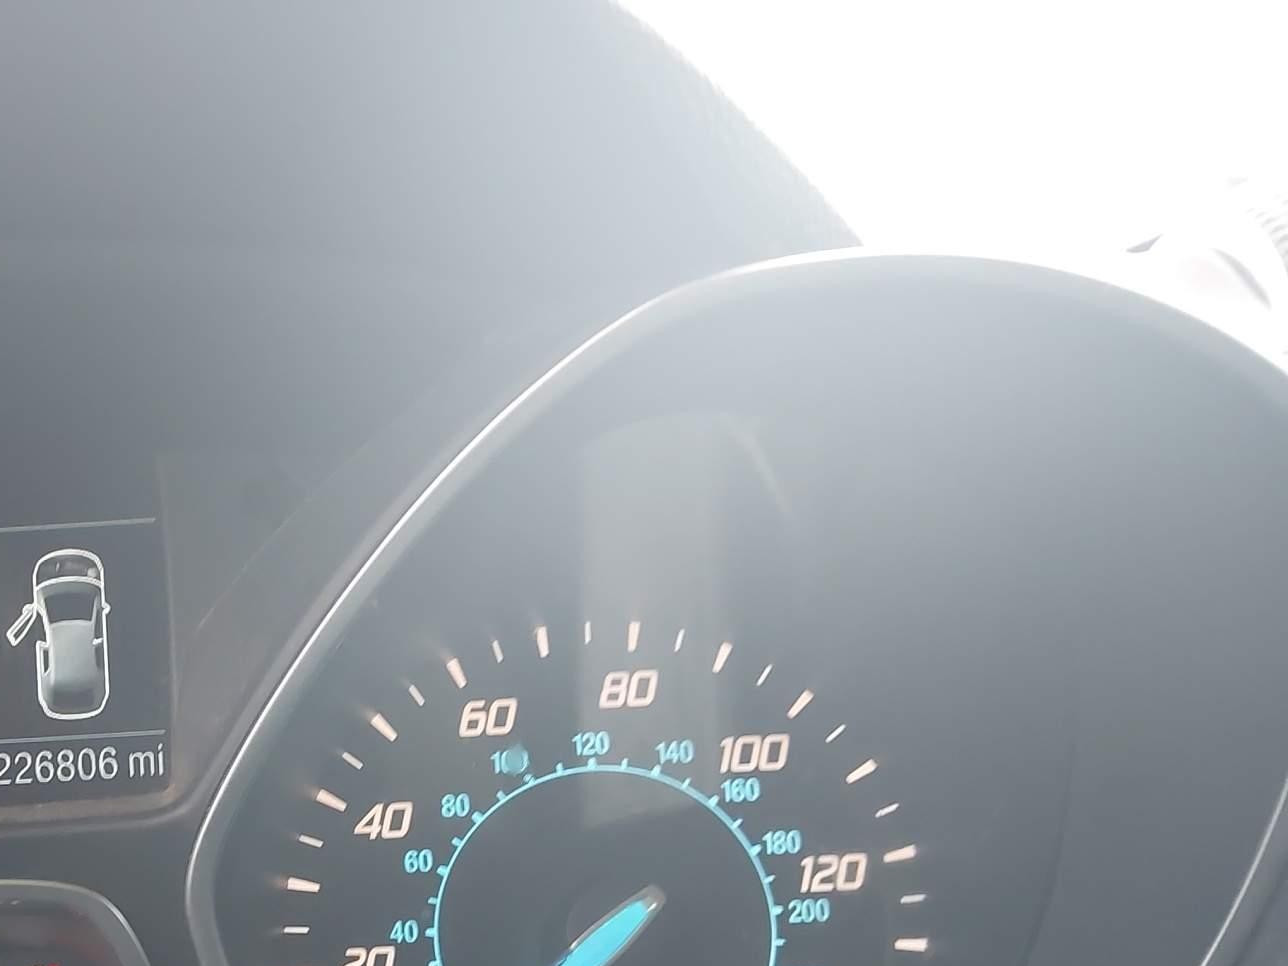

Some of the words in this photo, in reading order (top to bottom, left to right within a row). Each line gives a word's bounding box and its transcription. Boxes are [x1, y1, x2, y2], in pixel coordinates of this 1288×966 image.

[599, 669, 659, 710] 80
[458, 697, 518, 738] 60
[572, 731, 610, 756] 120
[655, 739, 696, 766] 140
[718, 733, 790, 774] 100
[128, 743, 166, 779] mi
[721, 777, 761, 802] 160
[440, 793, 471, 819] 80
[352, 800, 414, 842] 40
[762, 829, 802, 855] 180
[403, 848, 433, 874] 60
[799, 852, 868, 894] 120
[788, 898, 830, 925] 200
[389, 919, 419, 945] 40
